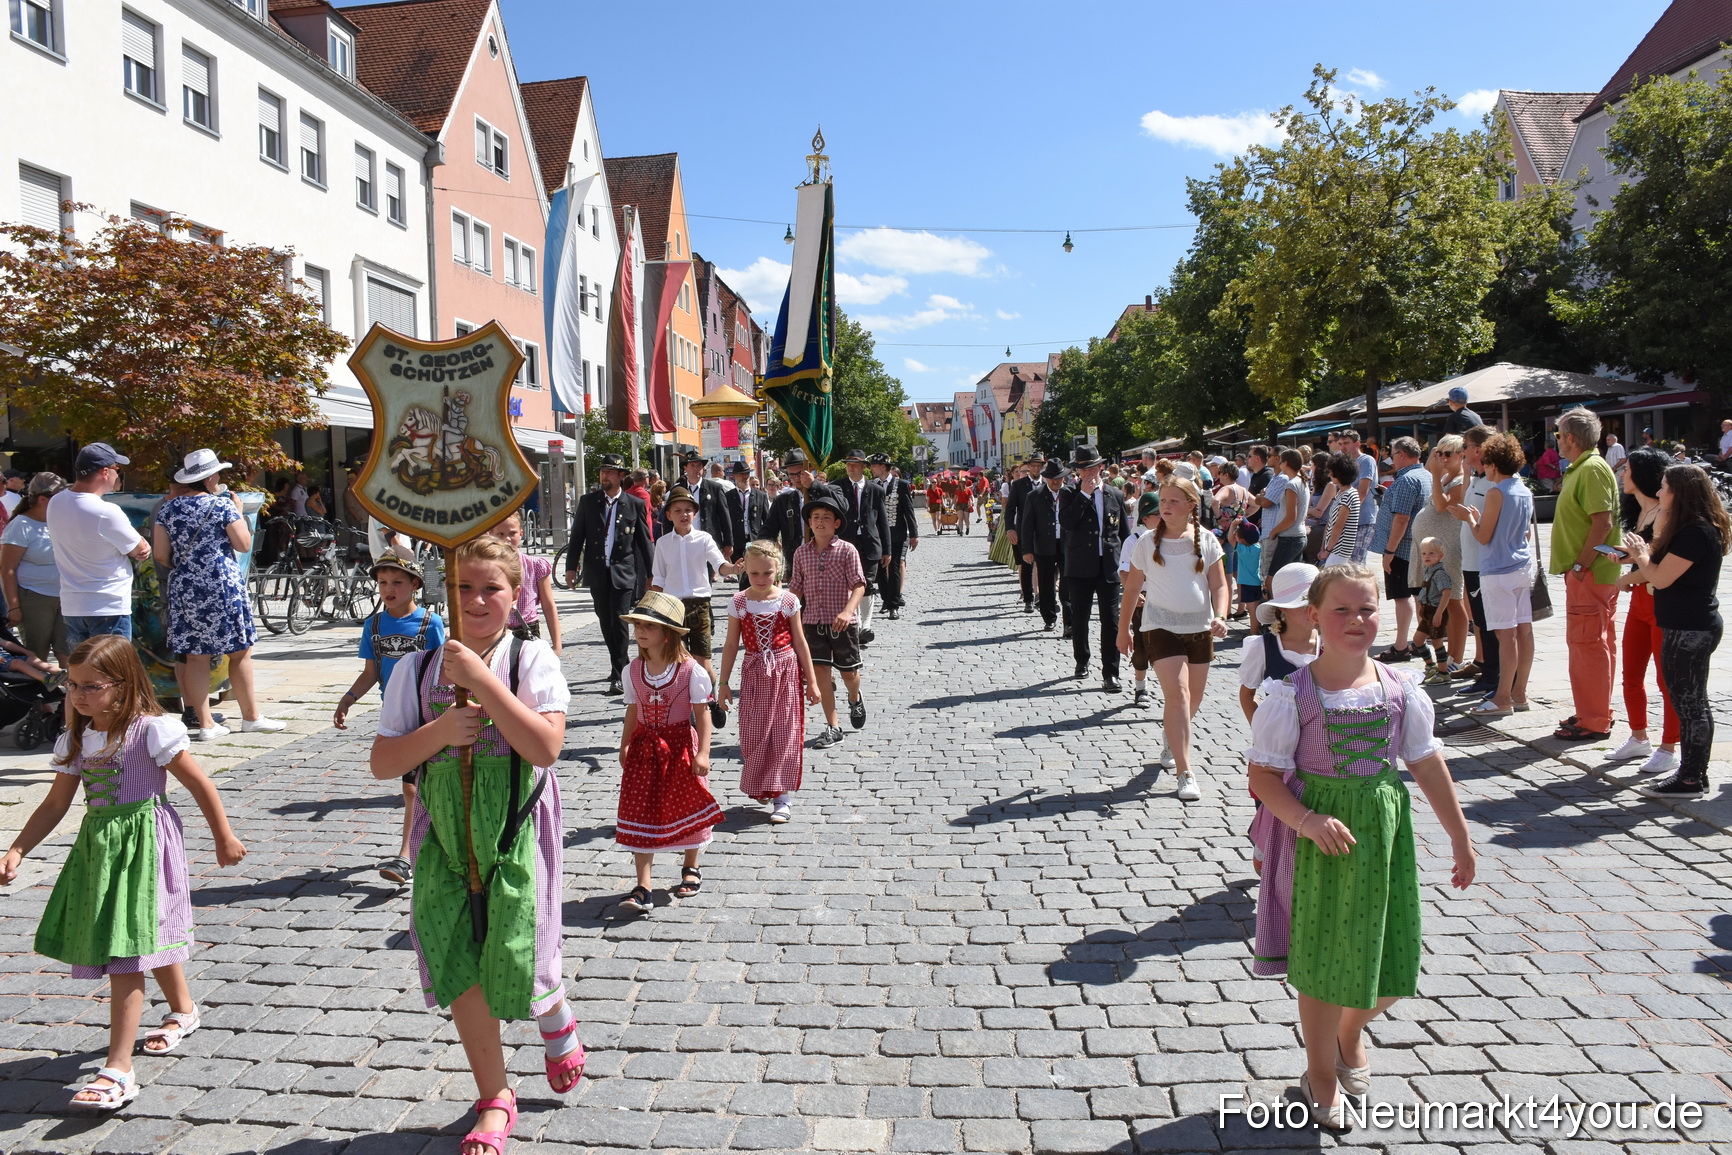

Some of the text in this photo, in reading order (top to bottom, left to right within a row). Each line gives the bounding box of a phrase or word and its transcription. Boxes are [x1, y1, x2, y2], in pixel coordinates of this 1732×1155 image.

[384, 343, 494, 368] ST. GEORG-
[390, 358, 494, 383] SCHÜTZEN
[756, 376, 768, 436] HOTEL
[376, 488, 488, 525] LODERBACH
